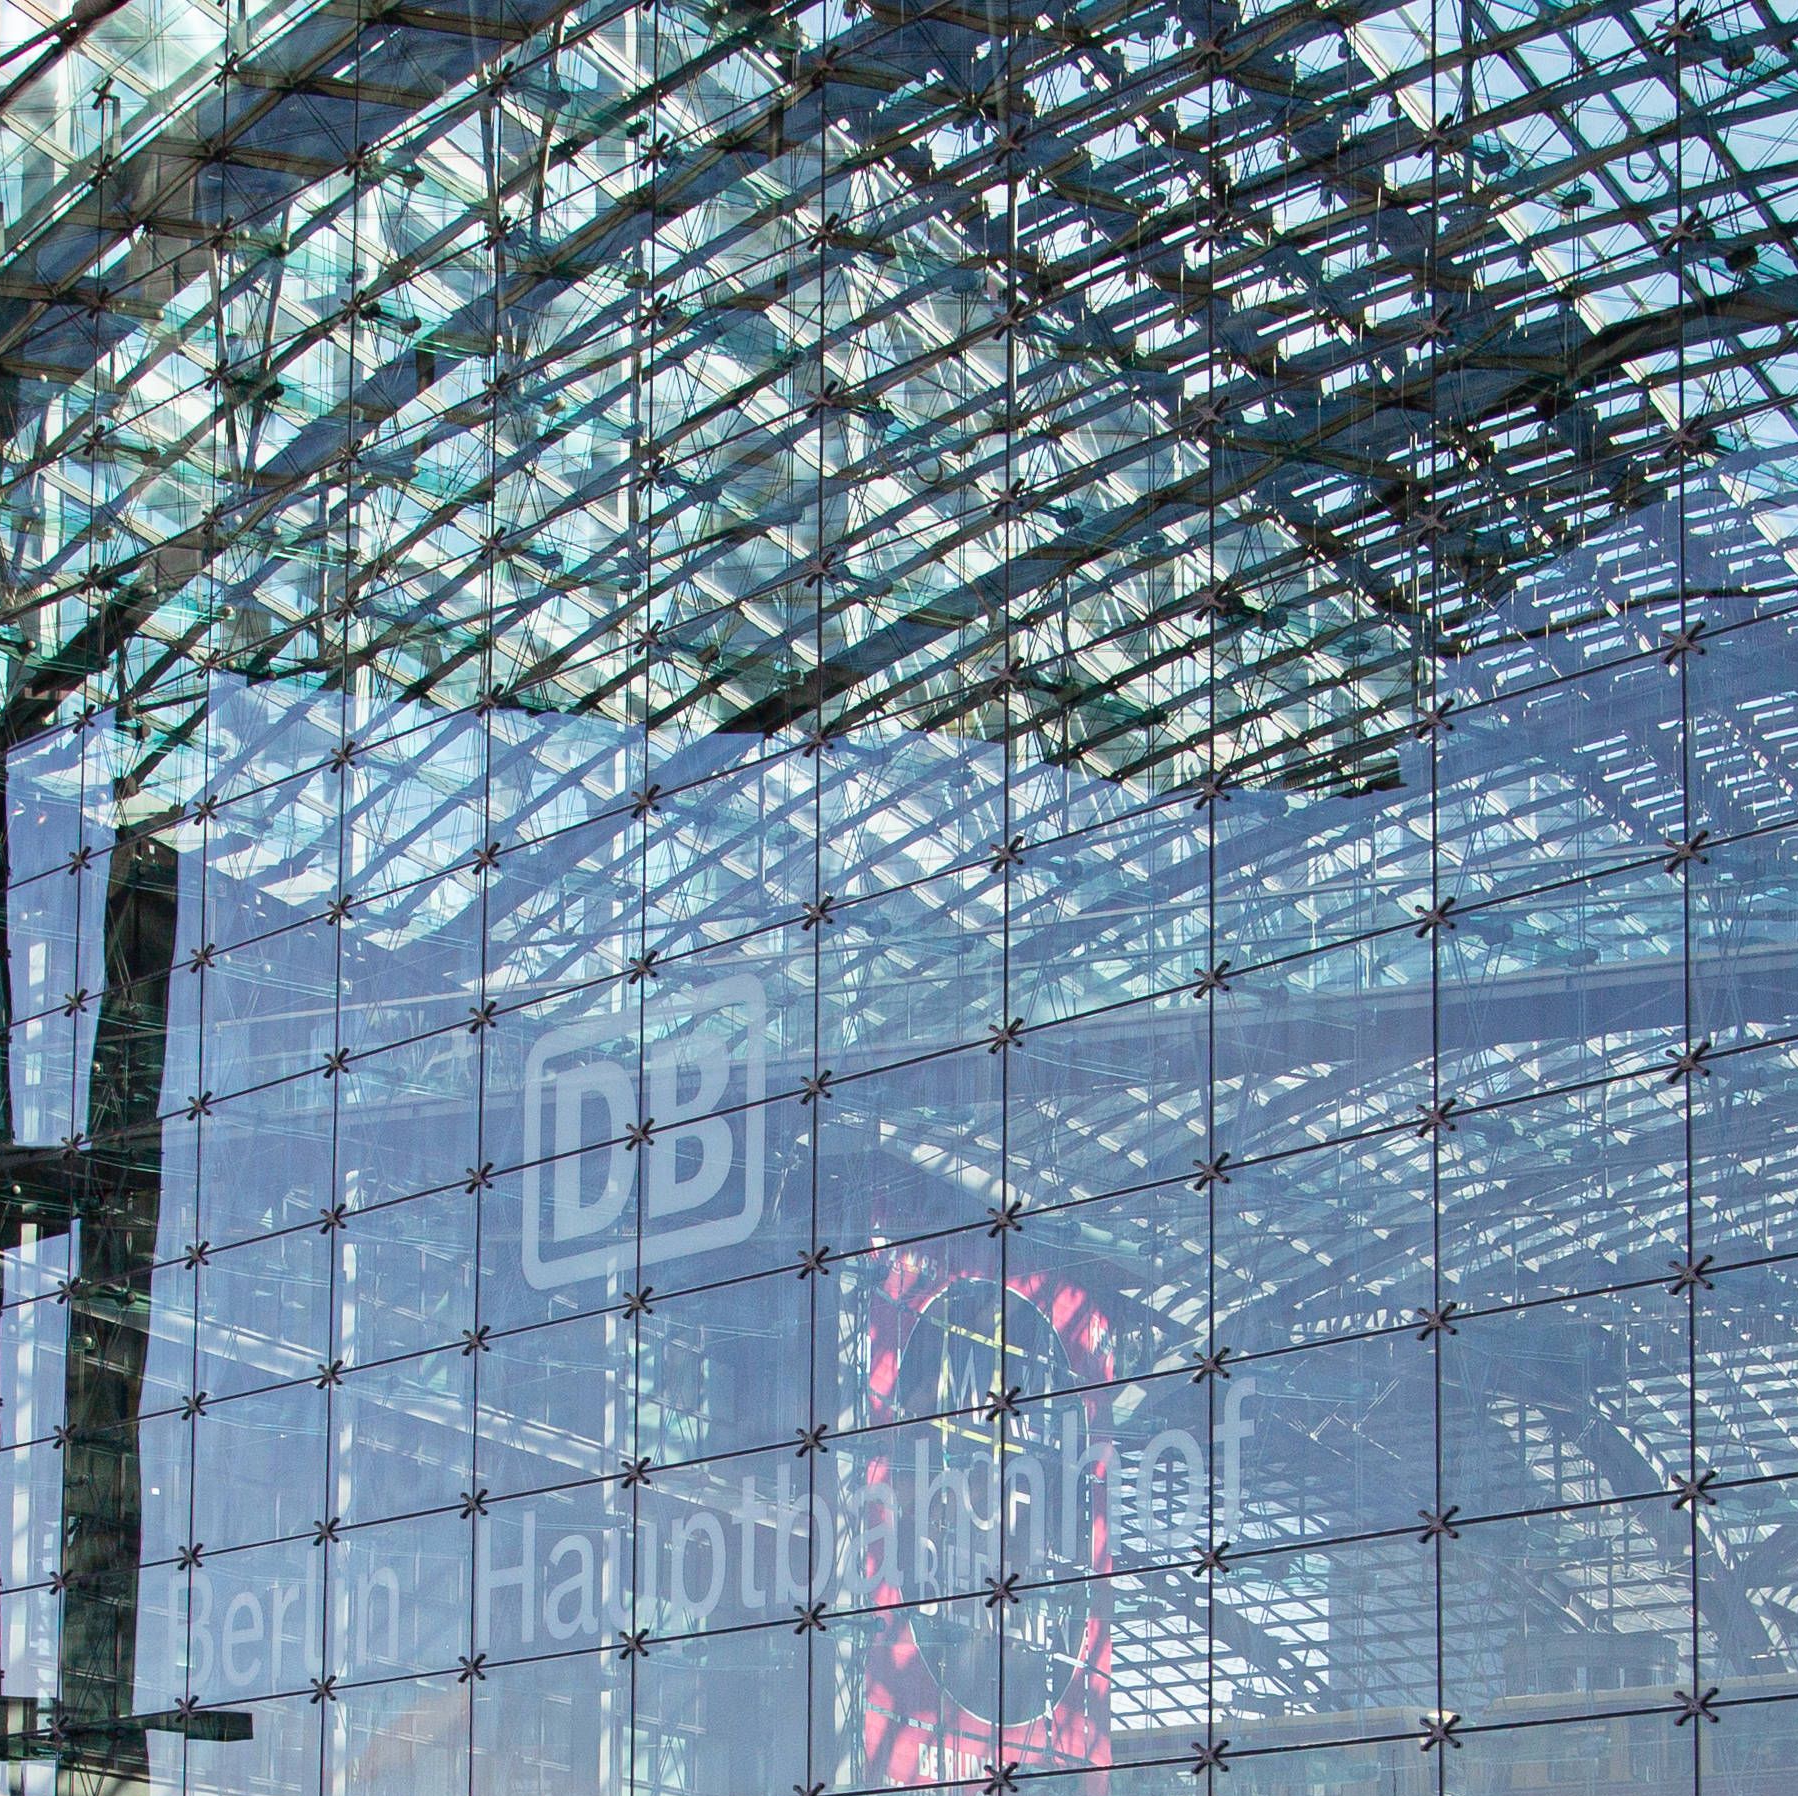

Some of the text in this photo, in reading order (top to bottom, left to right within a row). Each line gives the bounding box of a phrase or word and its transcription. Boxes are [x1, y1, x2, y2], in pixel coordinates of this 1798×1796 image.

[553, 1035, 735, 1242] DB
[168, 1377, 1257, 1687] Berlin Hauptbahnhof
